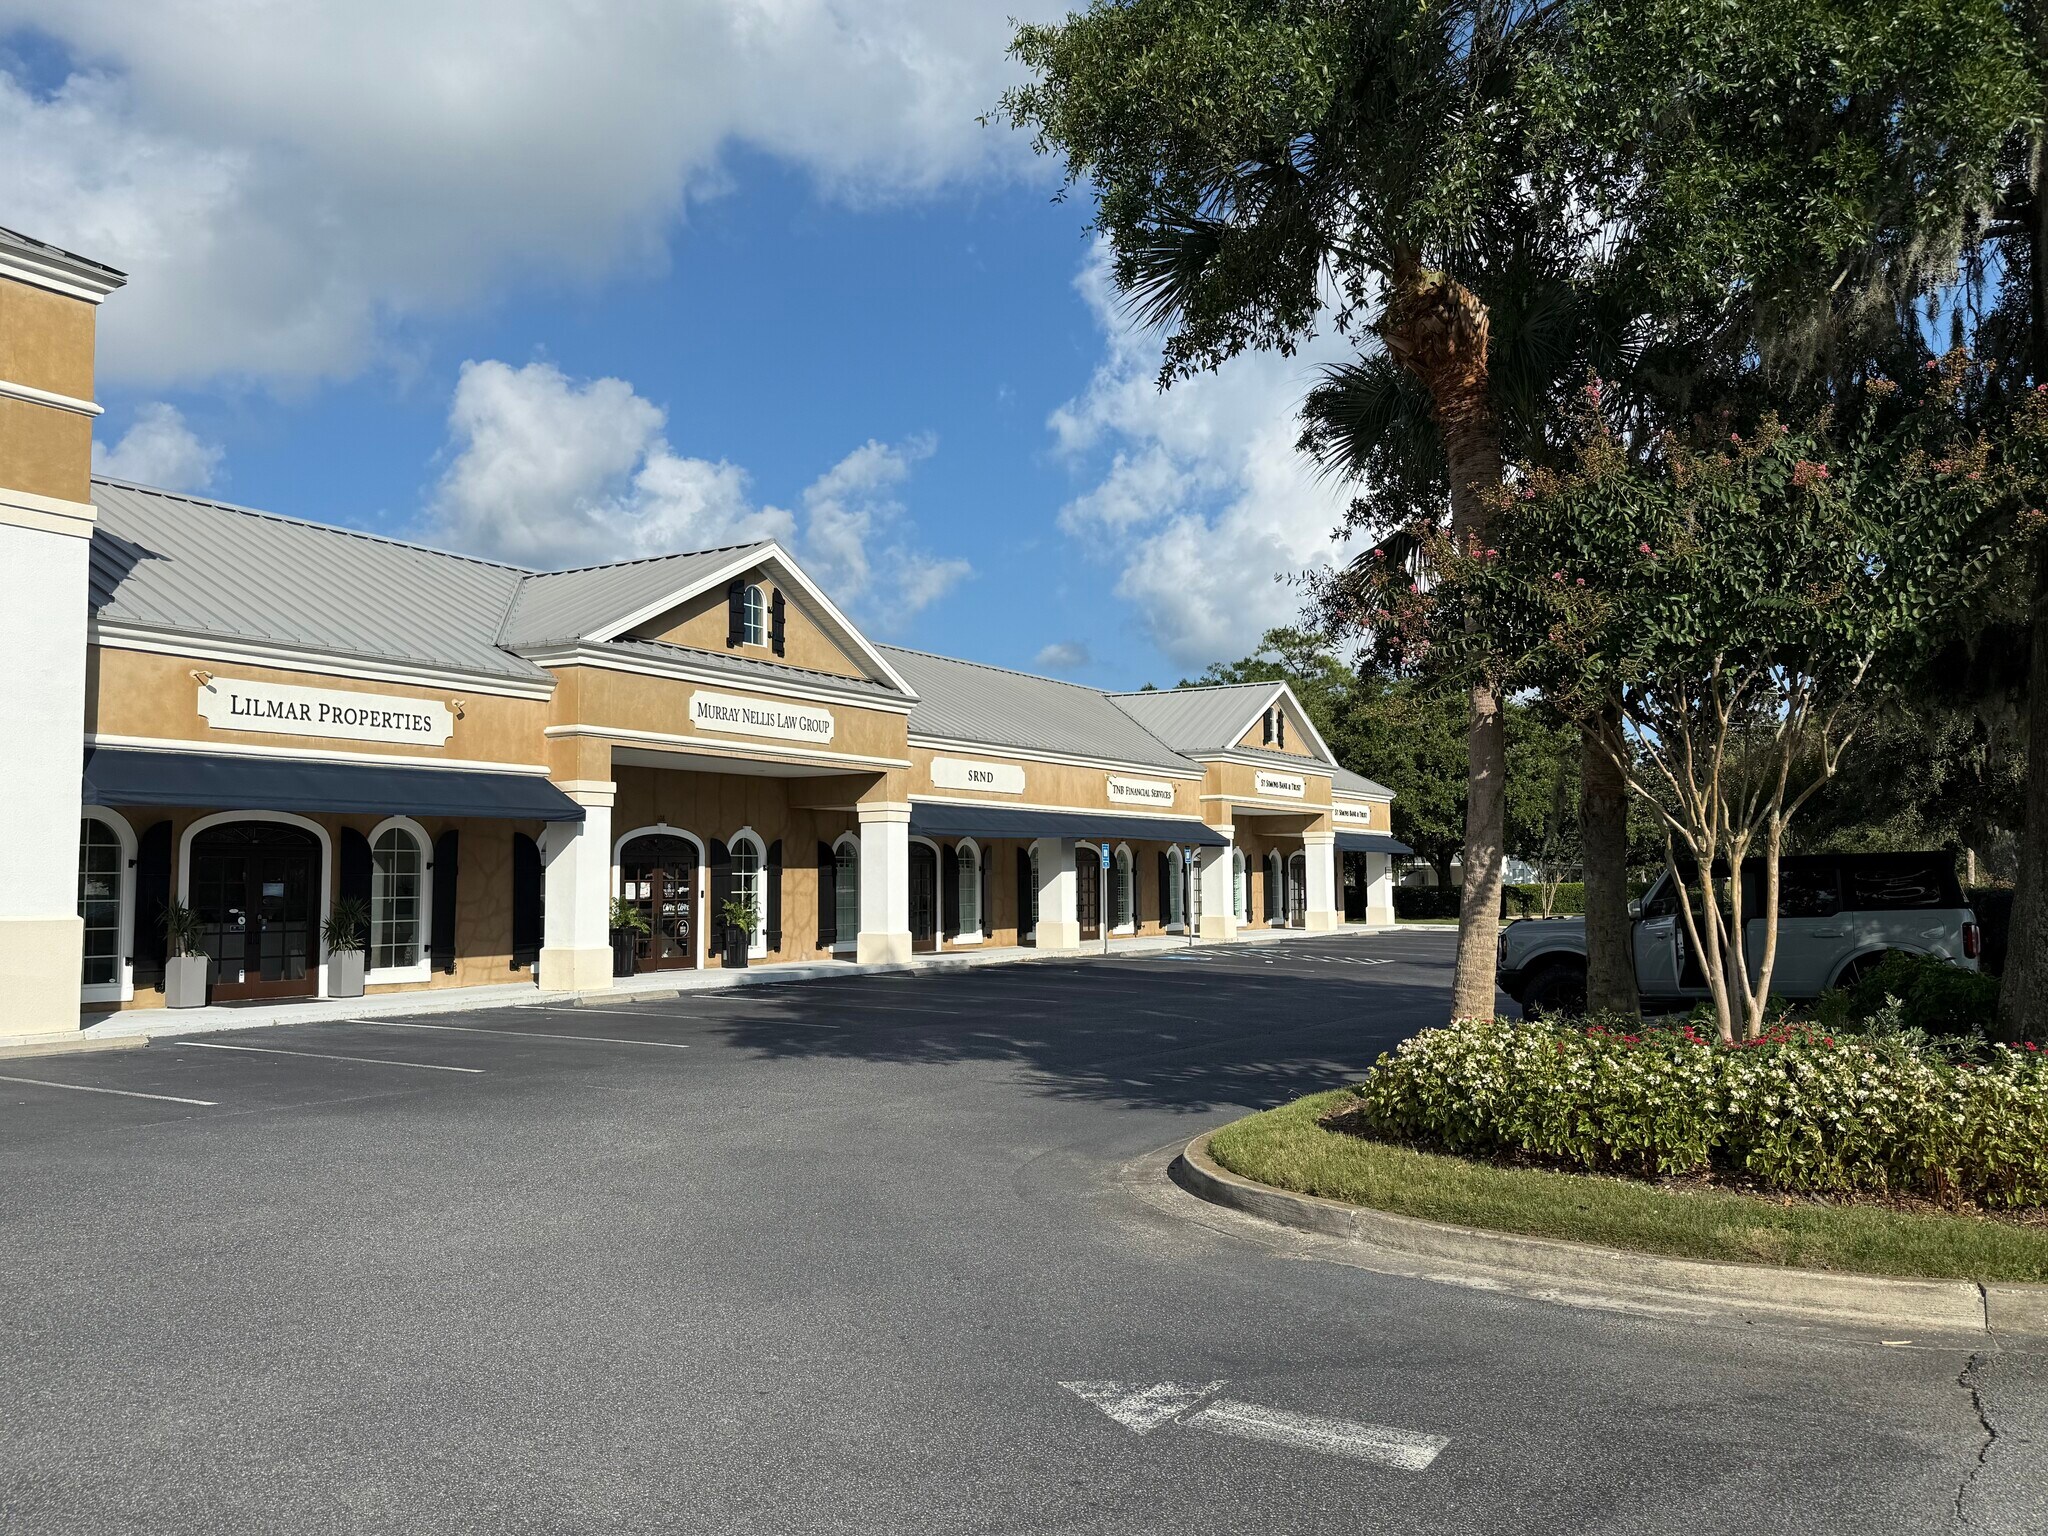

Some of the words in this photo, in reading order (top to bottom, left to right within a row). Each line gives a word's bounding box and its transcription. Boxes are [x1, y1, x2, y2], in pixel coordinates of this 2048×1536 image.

[230, 694, 312, 721] LILMAR
[318, 703, 432, 732] PROPERTIES
[697, 701, 740, 722] MURRAY
[742, 708, 775, 727] NELLIS
[777, 713, 798, 729] LAW
[799, 716, 830, 734] GROUP
[968, 769, 994, 783] SRND
[1112, 784, 1125, 795] TNB
[1125, 786, 1151, 797] FINANCIAL
[1151, 788, 1172, 799] SERVICES
